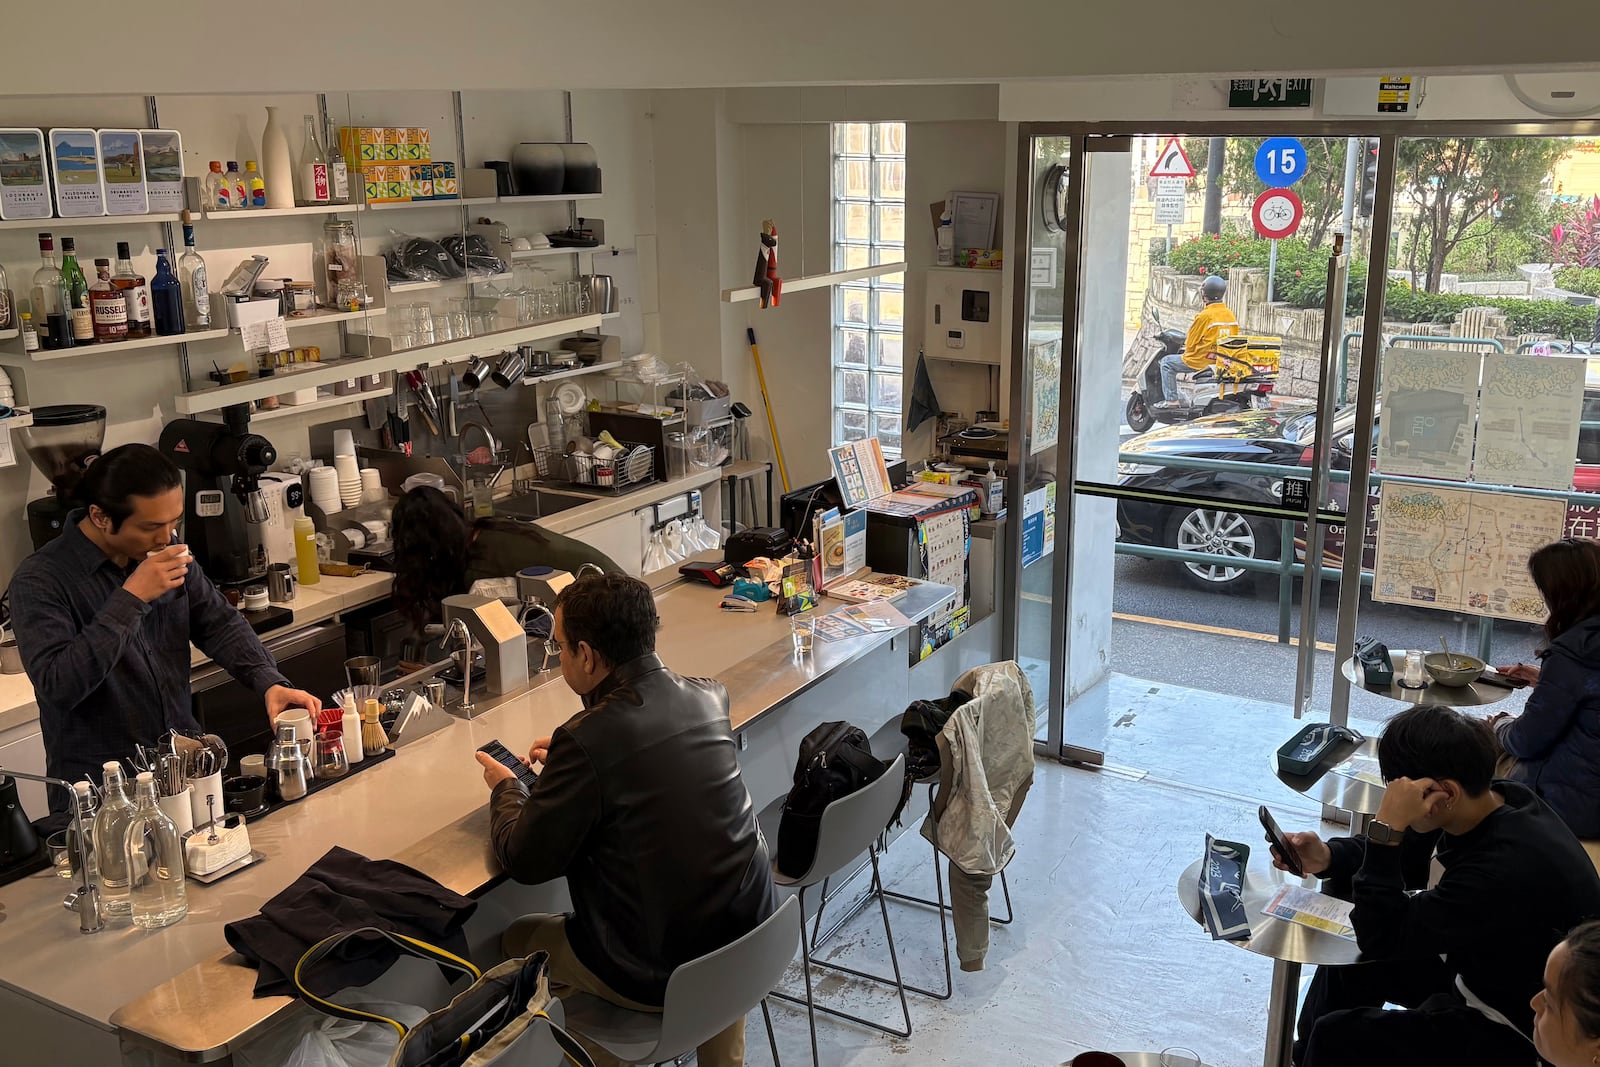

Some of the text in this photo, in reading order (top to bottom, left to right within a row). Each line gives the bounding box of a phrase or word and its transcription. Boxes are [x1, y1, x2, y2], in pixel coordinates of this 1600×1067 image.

[1266, 148, 1296, 175] 15
[108, 325, 117, 334] 10
[1285, 480, 1303, 497] 推
